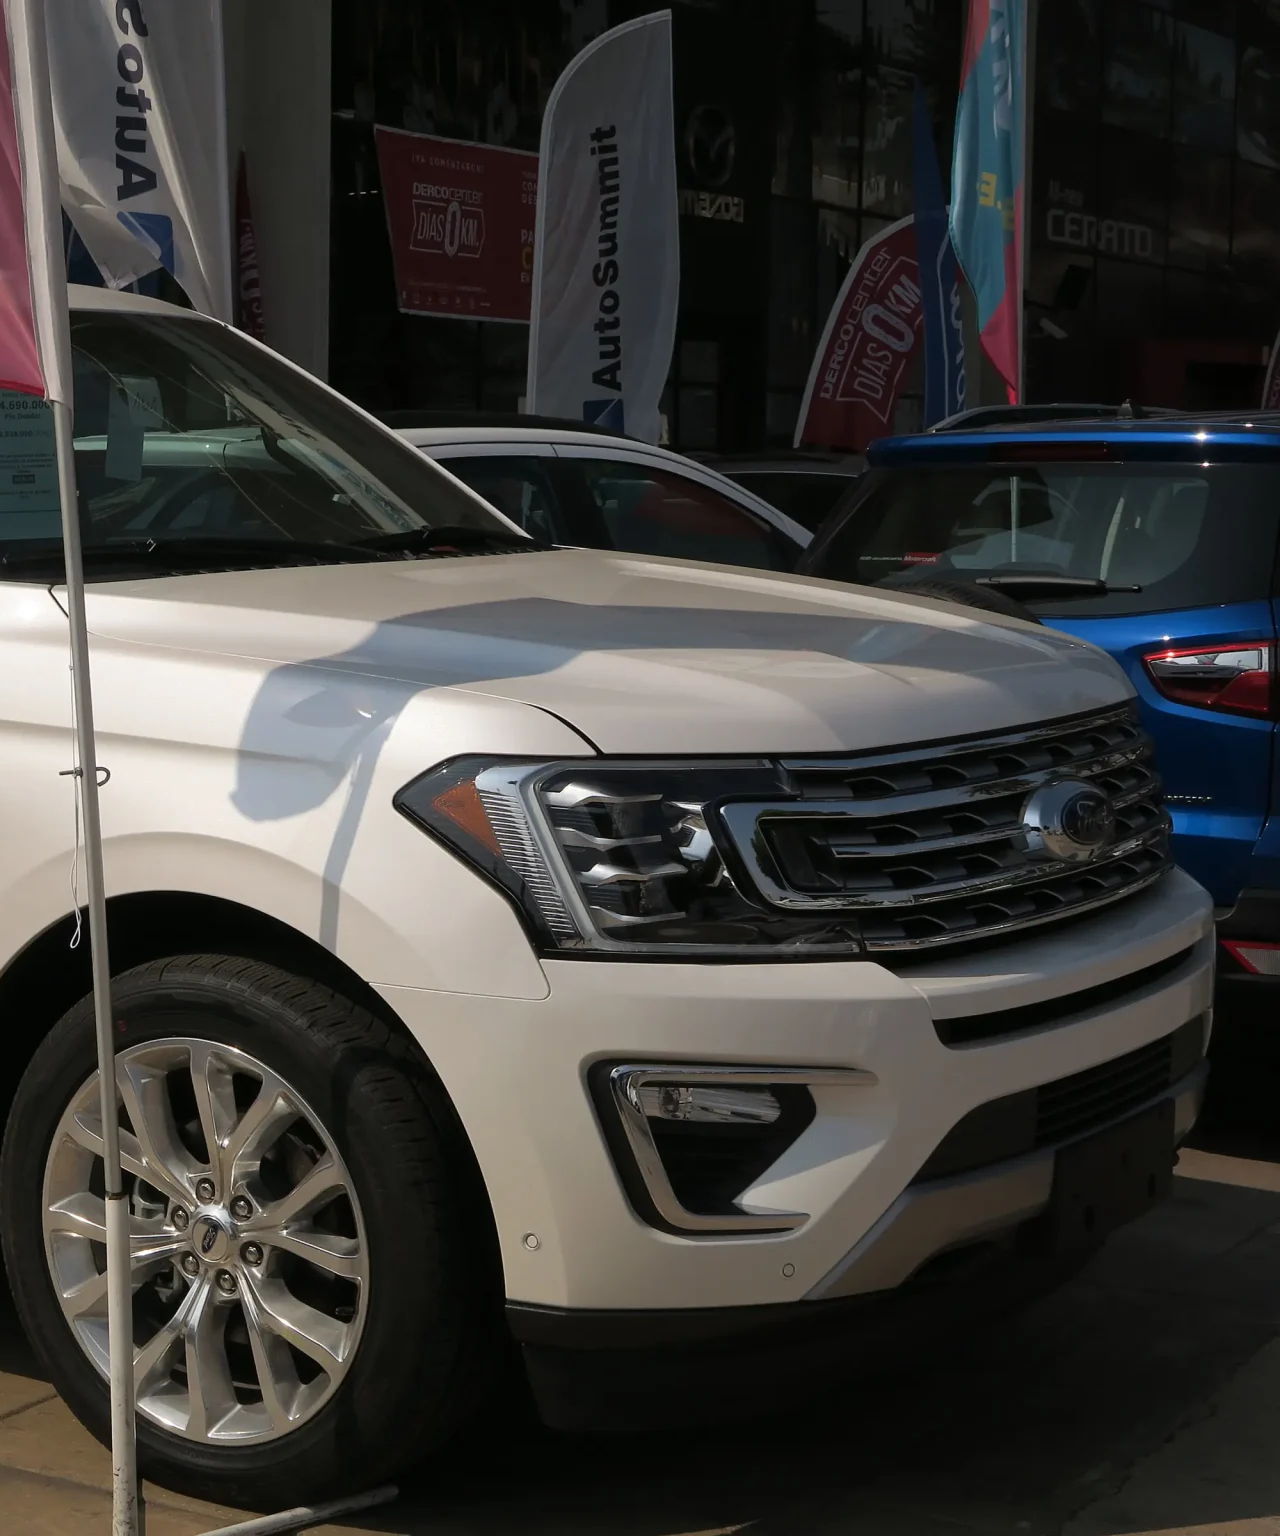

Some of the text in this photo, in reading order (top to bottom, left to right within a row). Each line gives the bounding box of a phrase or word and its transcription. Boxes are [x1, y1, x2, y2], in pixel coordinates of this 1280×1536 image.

[417, 207, 445, 242] DÍAS
[1047, 208, 1152, 257] CERATO
[590, 125, 622, 391] AutoSummit
[853, 343, 893, 400] DÍAS
